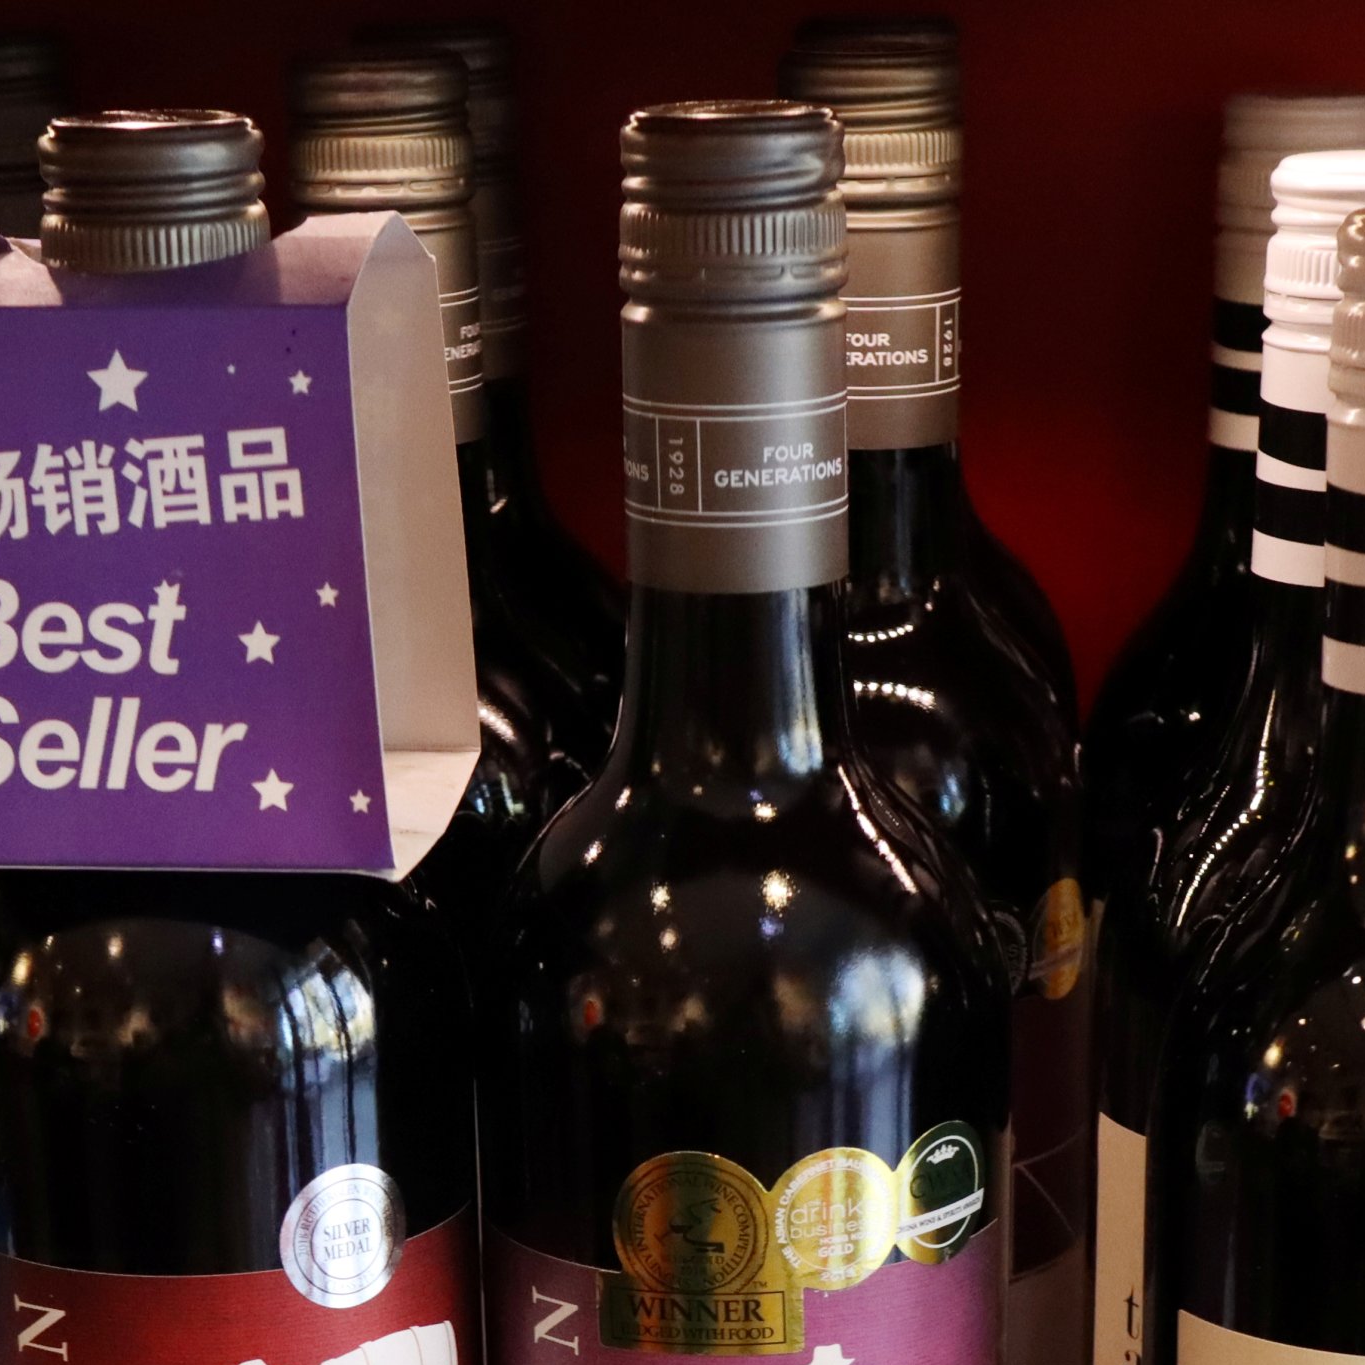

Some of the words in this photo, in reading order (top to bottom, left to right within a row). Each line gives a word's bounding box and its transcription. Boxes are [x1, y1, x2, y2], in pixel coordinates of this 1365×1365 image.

[763, 443, 814, 463] FOUR
[668, 437, 685, 495] 1928
[715, 457, 843, 488] GENERATIONS
[324, 1237, 373, 1262] MEDAL
[629, 1297, 765, 1323] WINNER
[729, 1326, 775, 1341] FOOD
